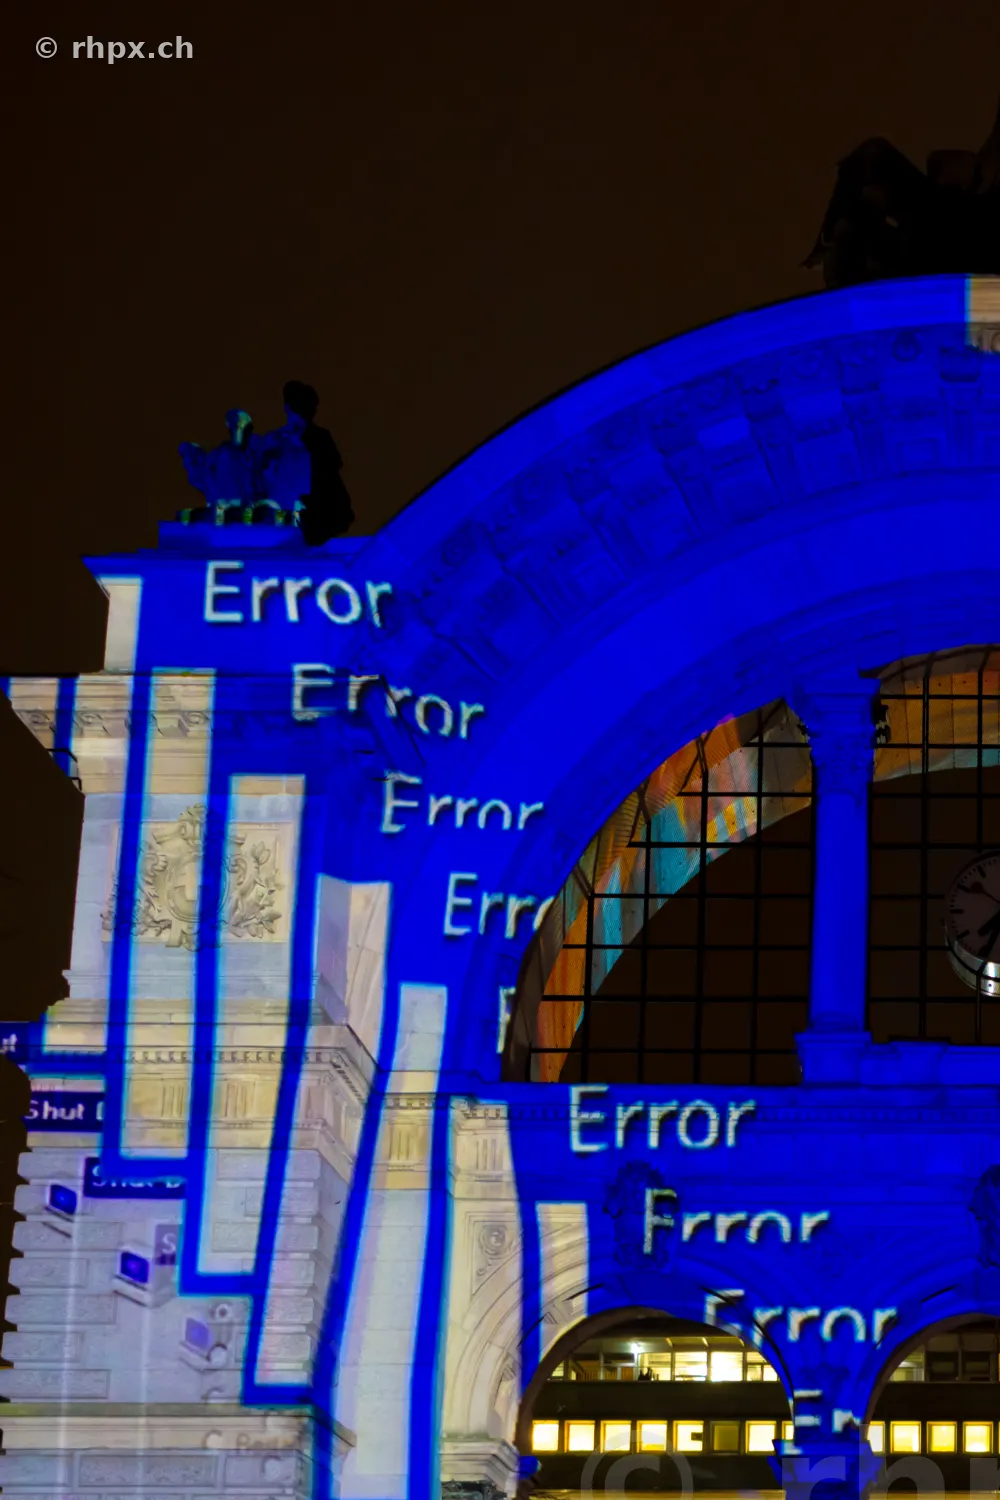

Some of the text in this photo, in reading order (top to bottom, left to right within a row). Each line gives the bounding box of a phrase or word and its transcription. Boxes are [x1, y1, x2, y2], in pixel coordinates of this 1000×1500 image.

[203, 560, 392, 627] Error
[291, 662, 485, 740] Error
[381, 769, 544, 834] Error
[569, 1084, 757, 1152] Error
